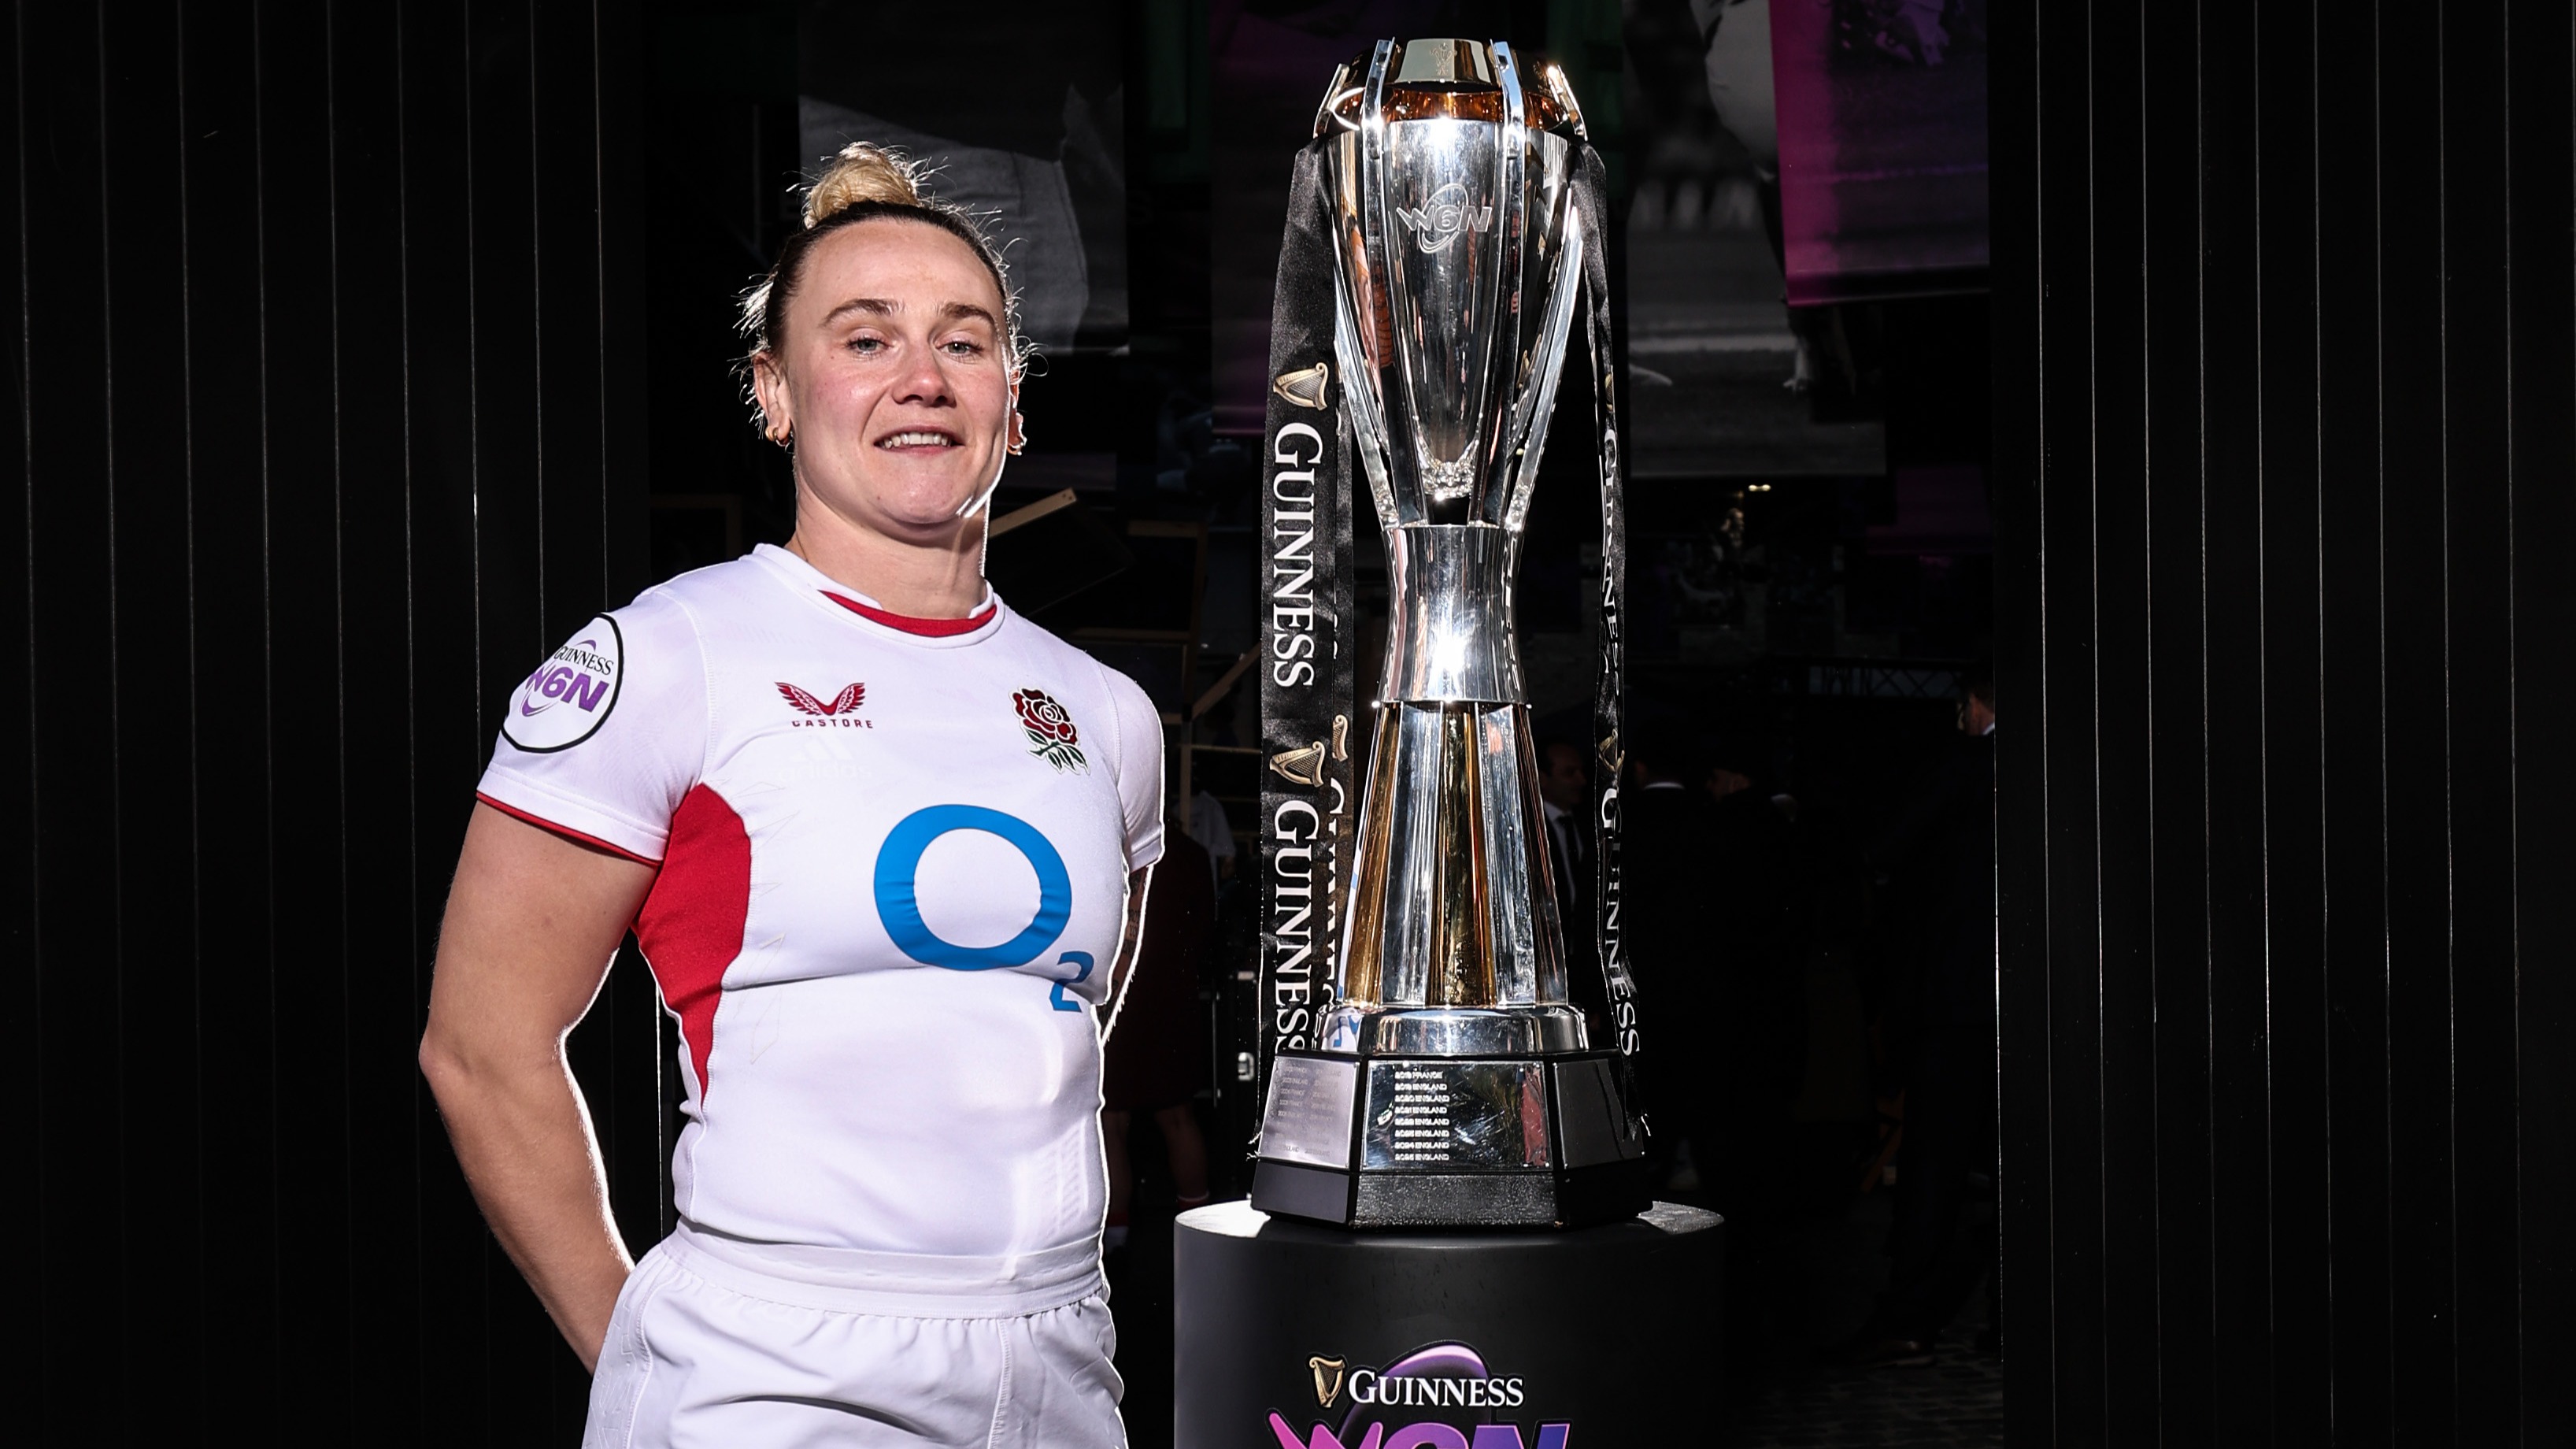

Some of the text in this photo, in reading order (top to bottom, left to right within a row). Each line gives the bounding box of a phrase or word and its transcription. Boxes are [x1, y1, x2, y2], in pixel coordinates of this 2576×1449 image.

[1273, 422, 1323, 687] GUINNESS
[553, 646, 614, 676] GUINNESS
[791, 718, 873, 728] CASTORE
[1349, 1369, 1524, 1407] GUINNESS
